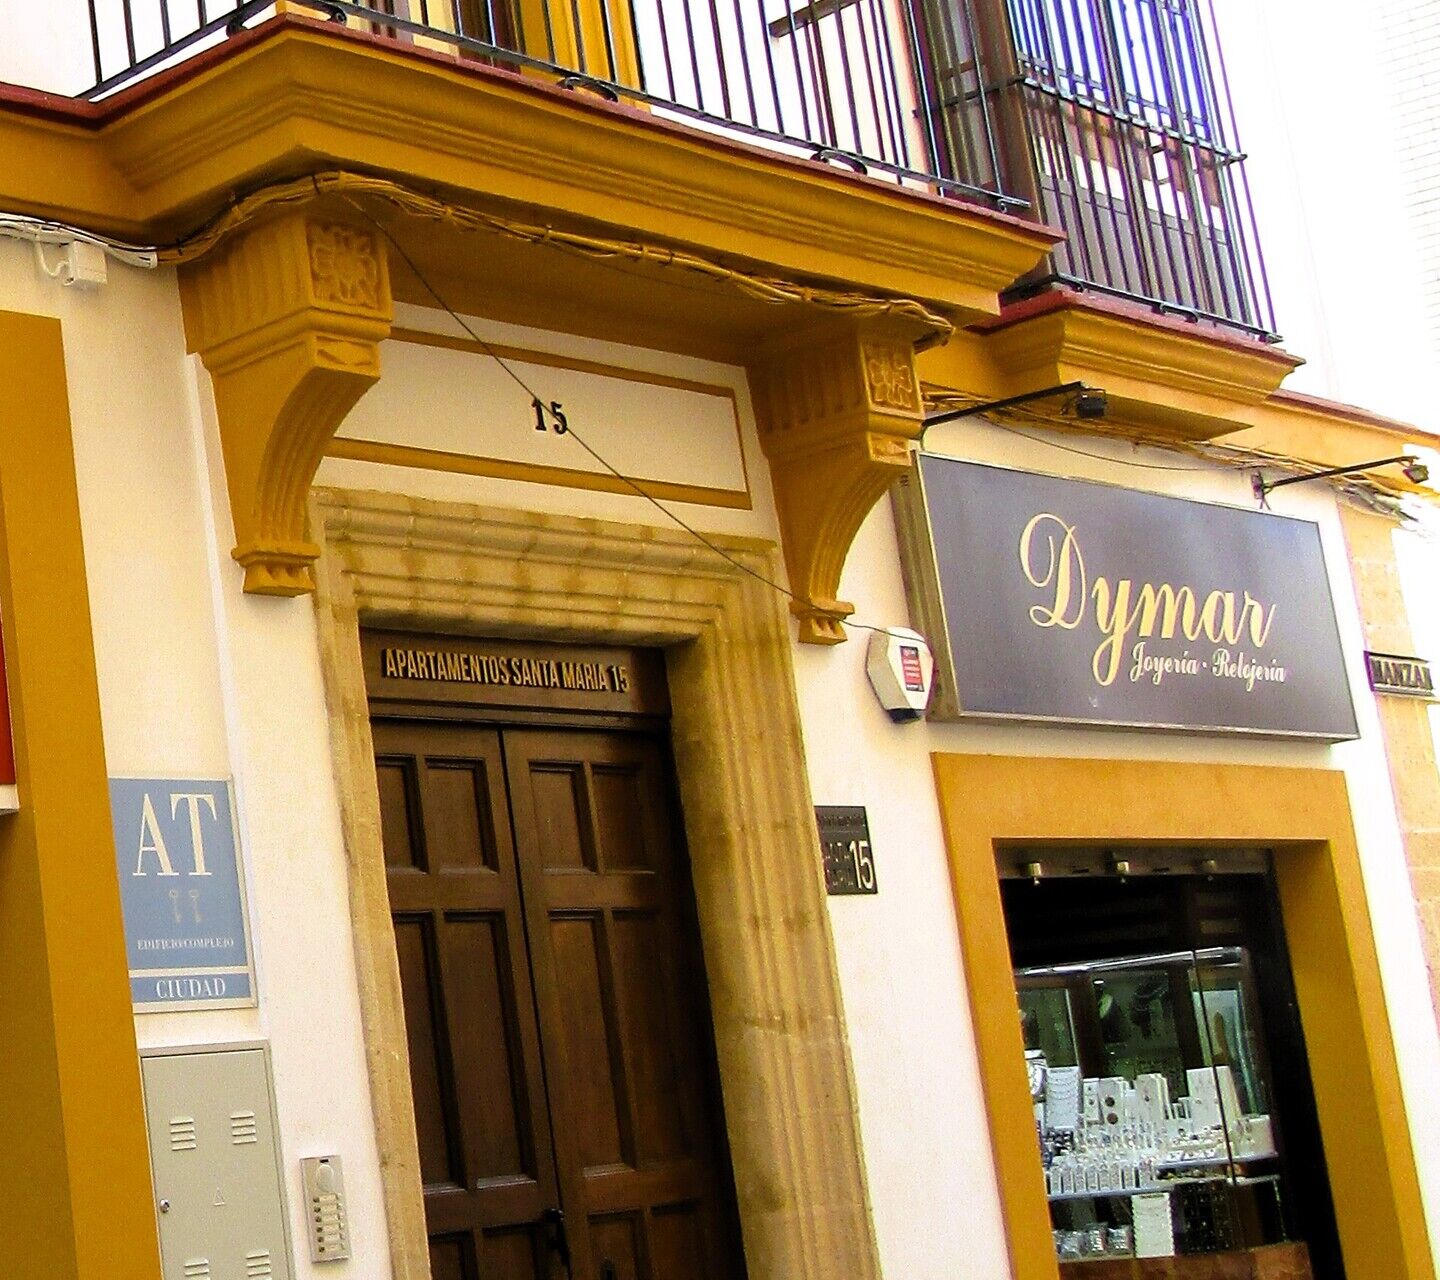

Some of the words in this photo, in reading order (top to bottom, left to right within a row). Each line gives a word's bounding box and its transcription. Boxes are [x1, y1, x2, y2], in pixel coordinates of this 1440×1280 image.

[530, 398, 568, 435] 15
[1019, 512, 1278, 687] Dymar
[384, 647, 510, 686] APARTAMENTOS
[511, 656, 561, 689] SANTA
[561, 660, 610, 692] MARIA
[611, 664, 631, 694] 15
[1129, 640, 1198, 686] Joyería
[1212, 648, 1287, 693] Relojería
[132, 792, 218, 877] AT
[849, 839, 875, 891] 15
[156, 977, 227, 999] CIUDAD
